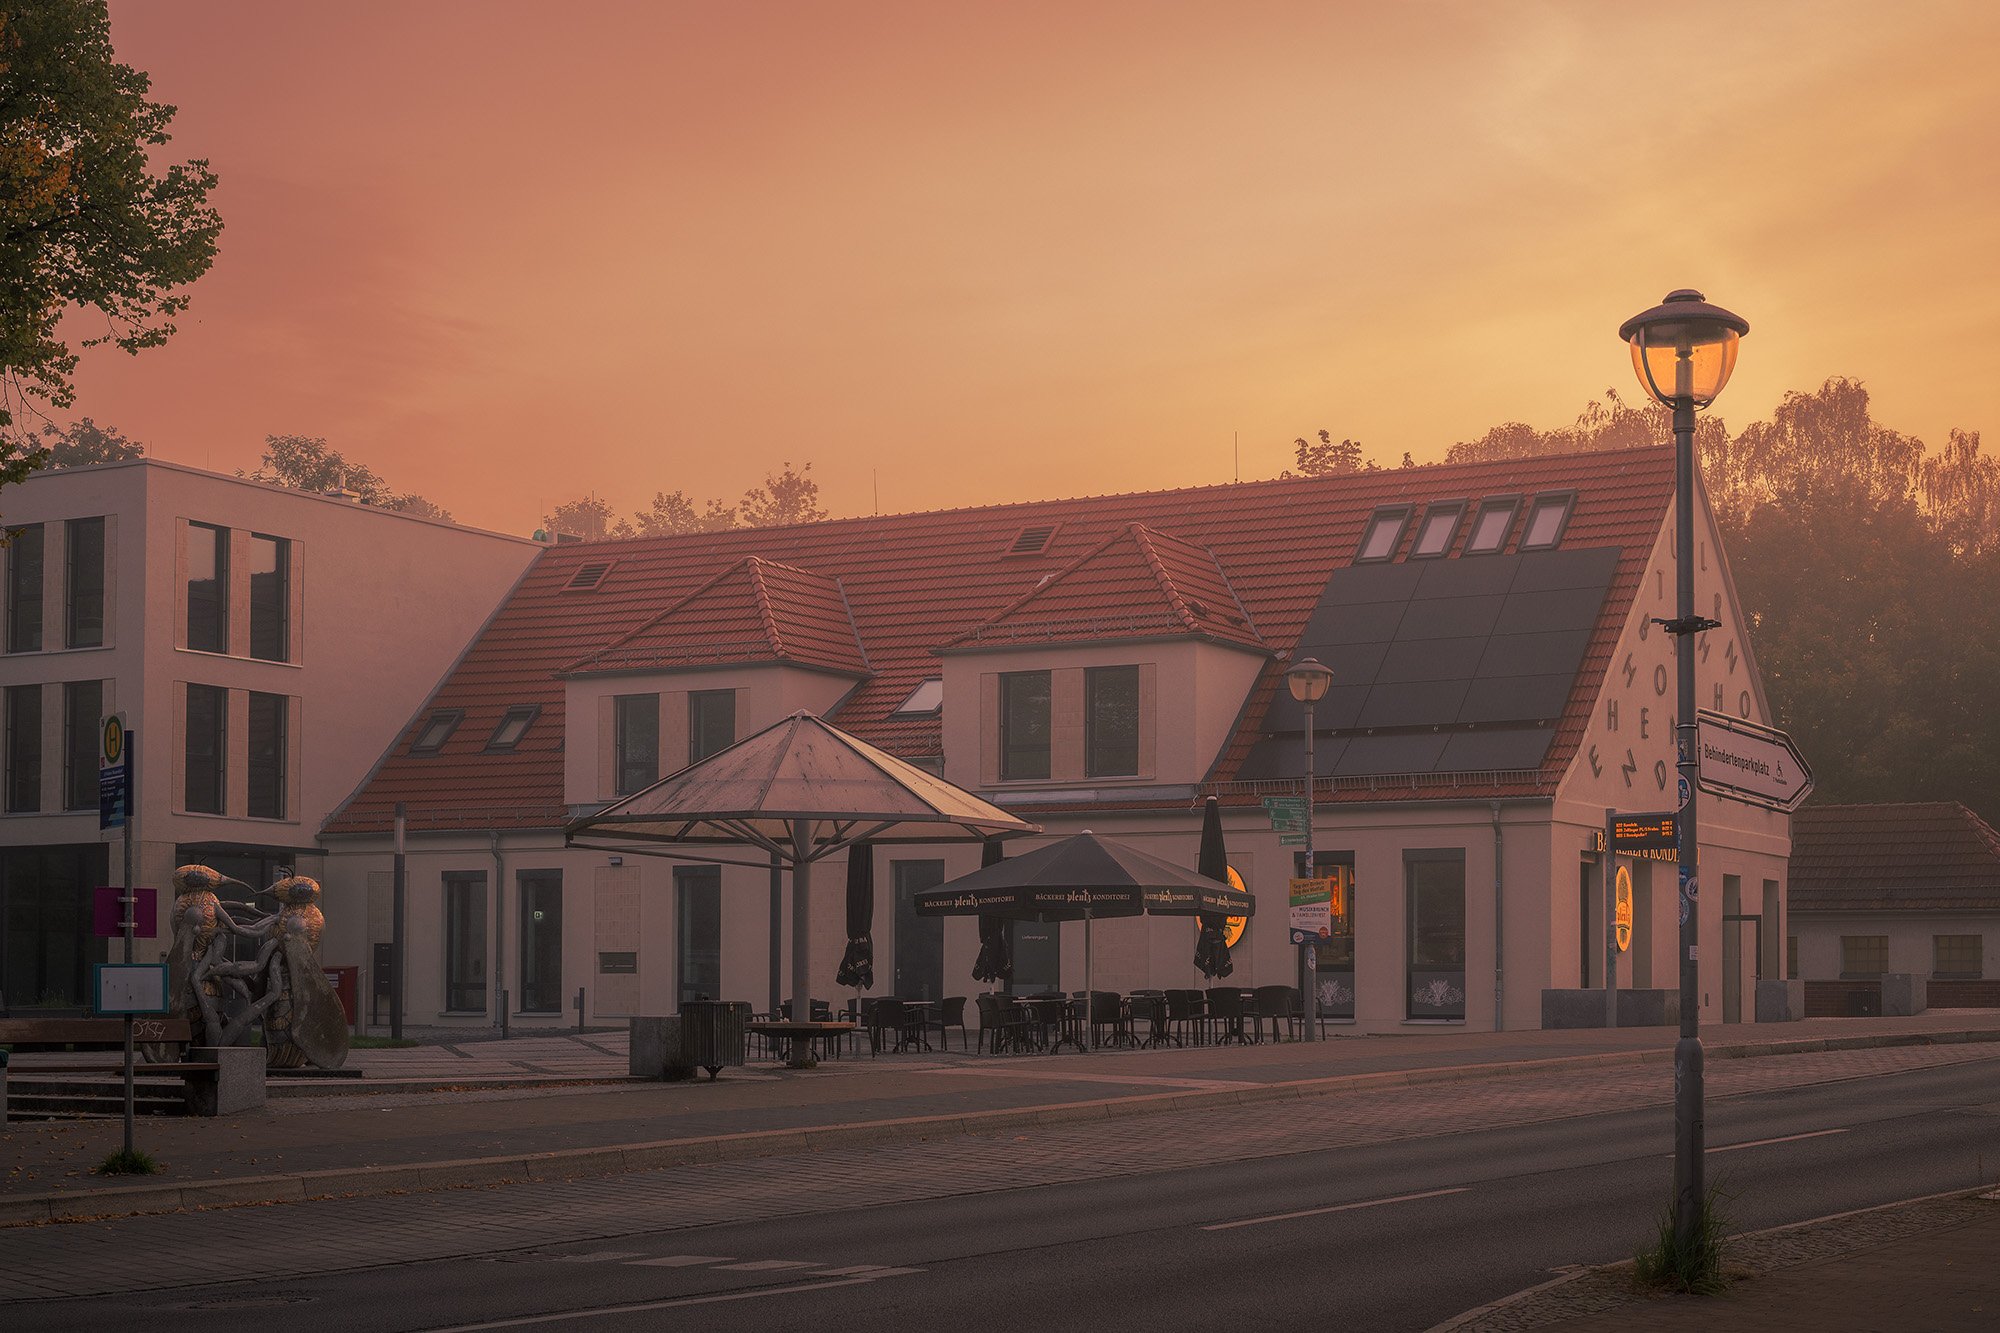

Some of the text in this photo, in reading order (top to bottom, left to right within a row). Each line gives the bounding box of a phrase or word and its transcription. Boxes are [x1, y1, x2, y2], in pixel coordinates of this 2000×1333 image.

[1704, 743, 1770, 776] Behindertenparkplatz
[924, 893, 1015, 909] BÄCKEREI plentz KONDITOREI
[1035, 893, 1065, 901] BÄCKEREI
[1066, 888, 1091, 903] plentz
